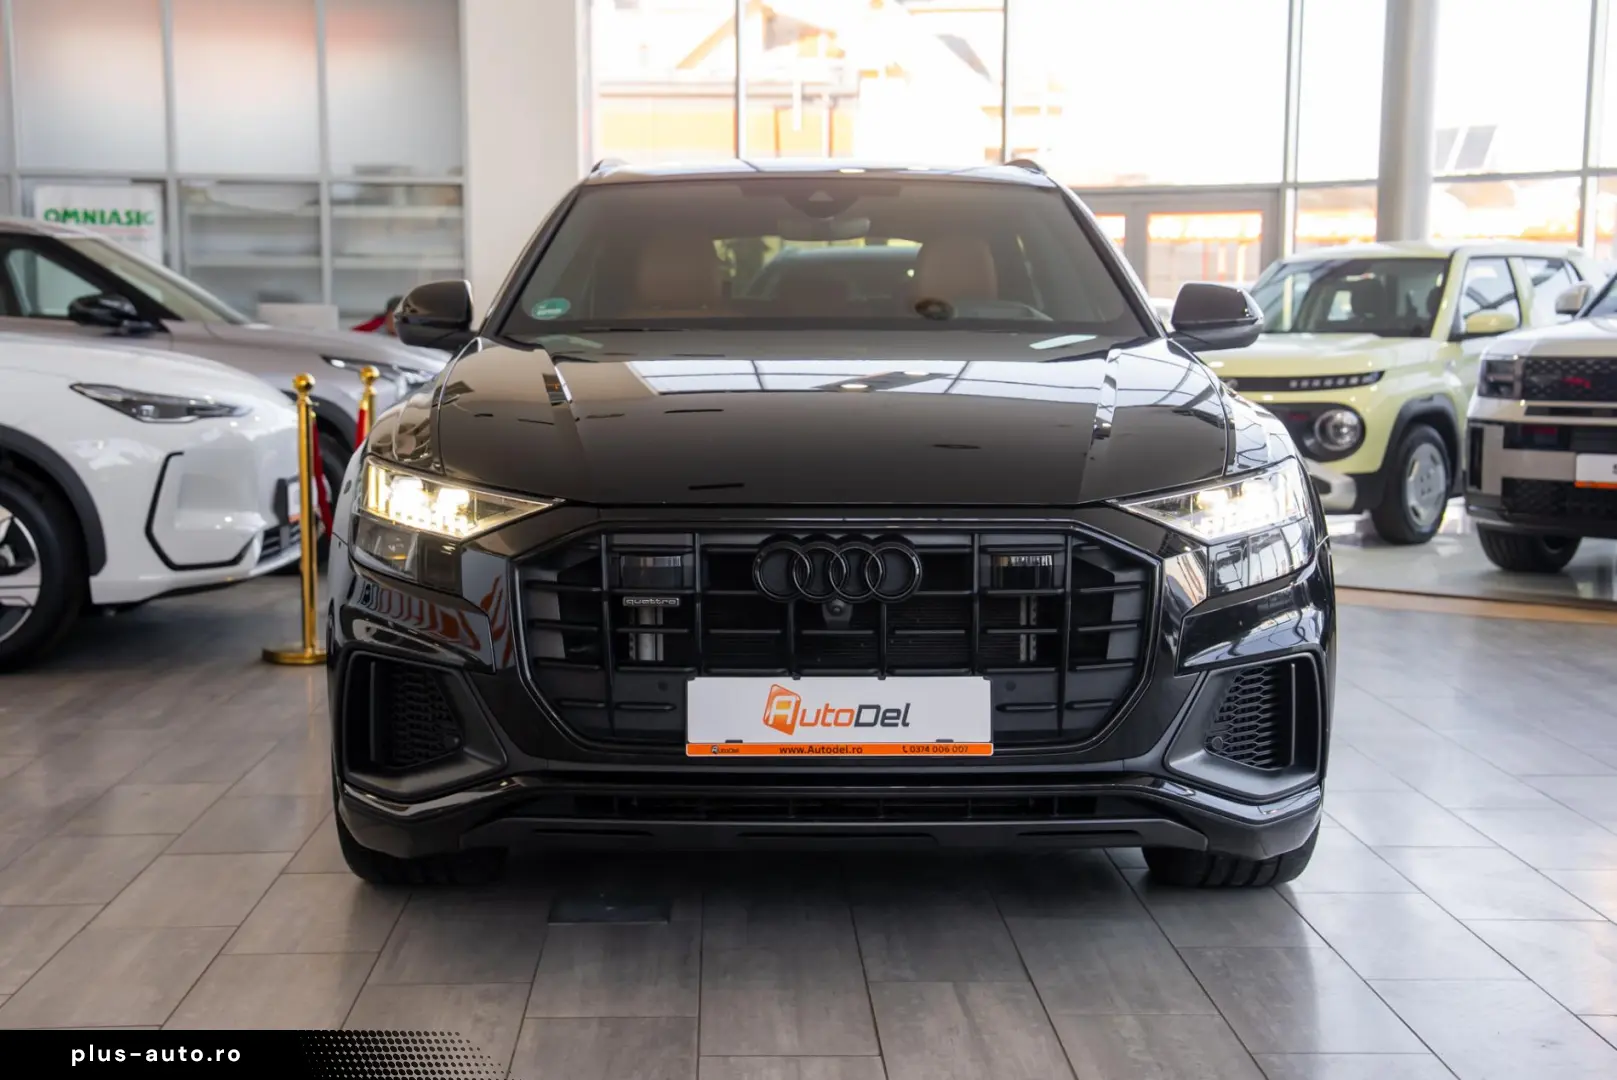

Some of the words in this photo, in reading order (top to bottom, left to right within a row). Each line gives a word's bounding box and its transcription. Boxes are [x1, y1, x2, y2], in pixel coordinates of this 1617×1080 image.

[625, 598, 677, 606] quattro
[764, 688, 911, 732] AutoDel
[779, 745, 863, 754] www.Autodel.ro
[909, 745, 930, 754] 0374
[932, 745, 950, 754] 006
[951, 745, 969, 754] 007
